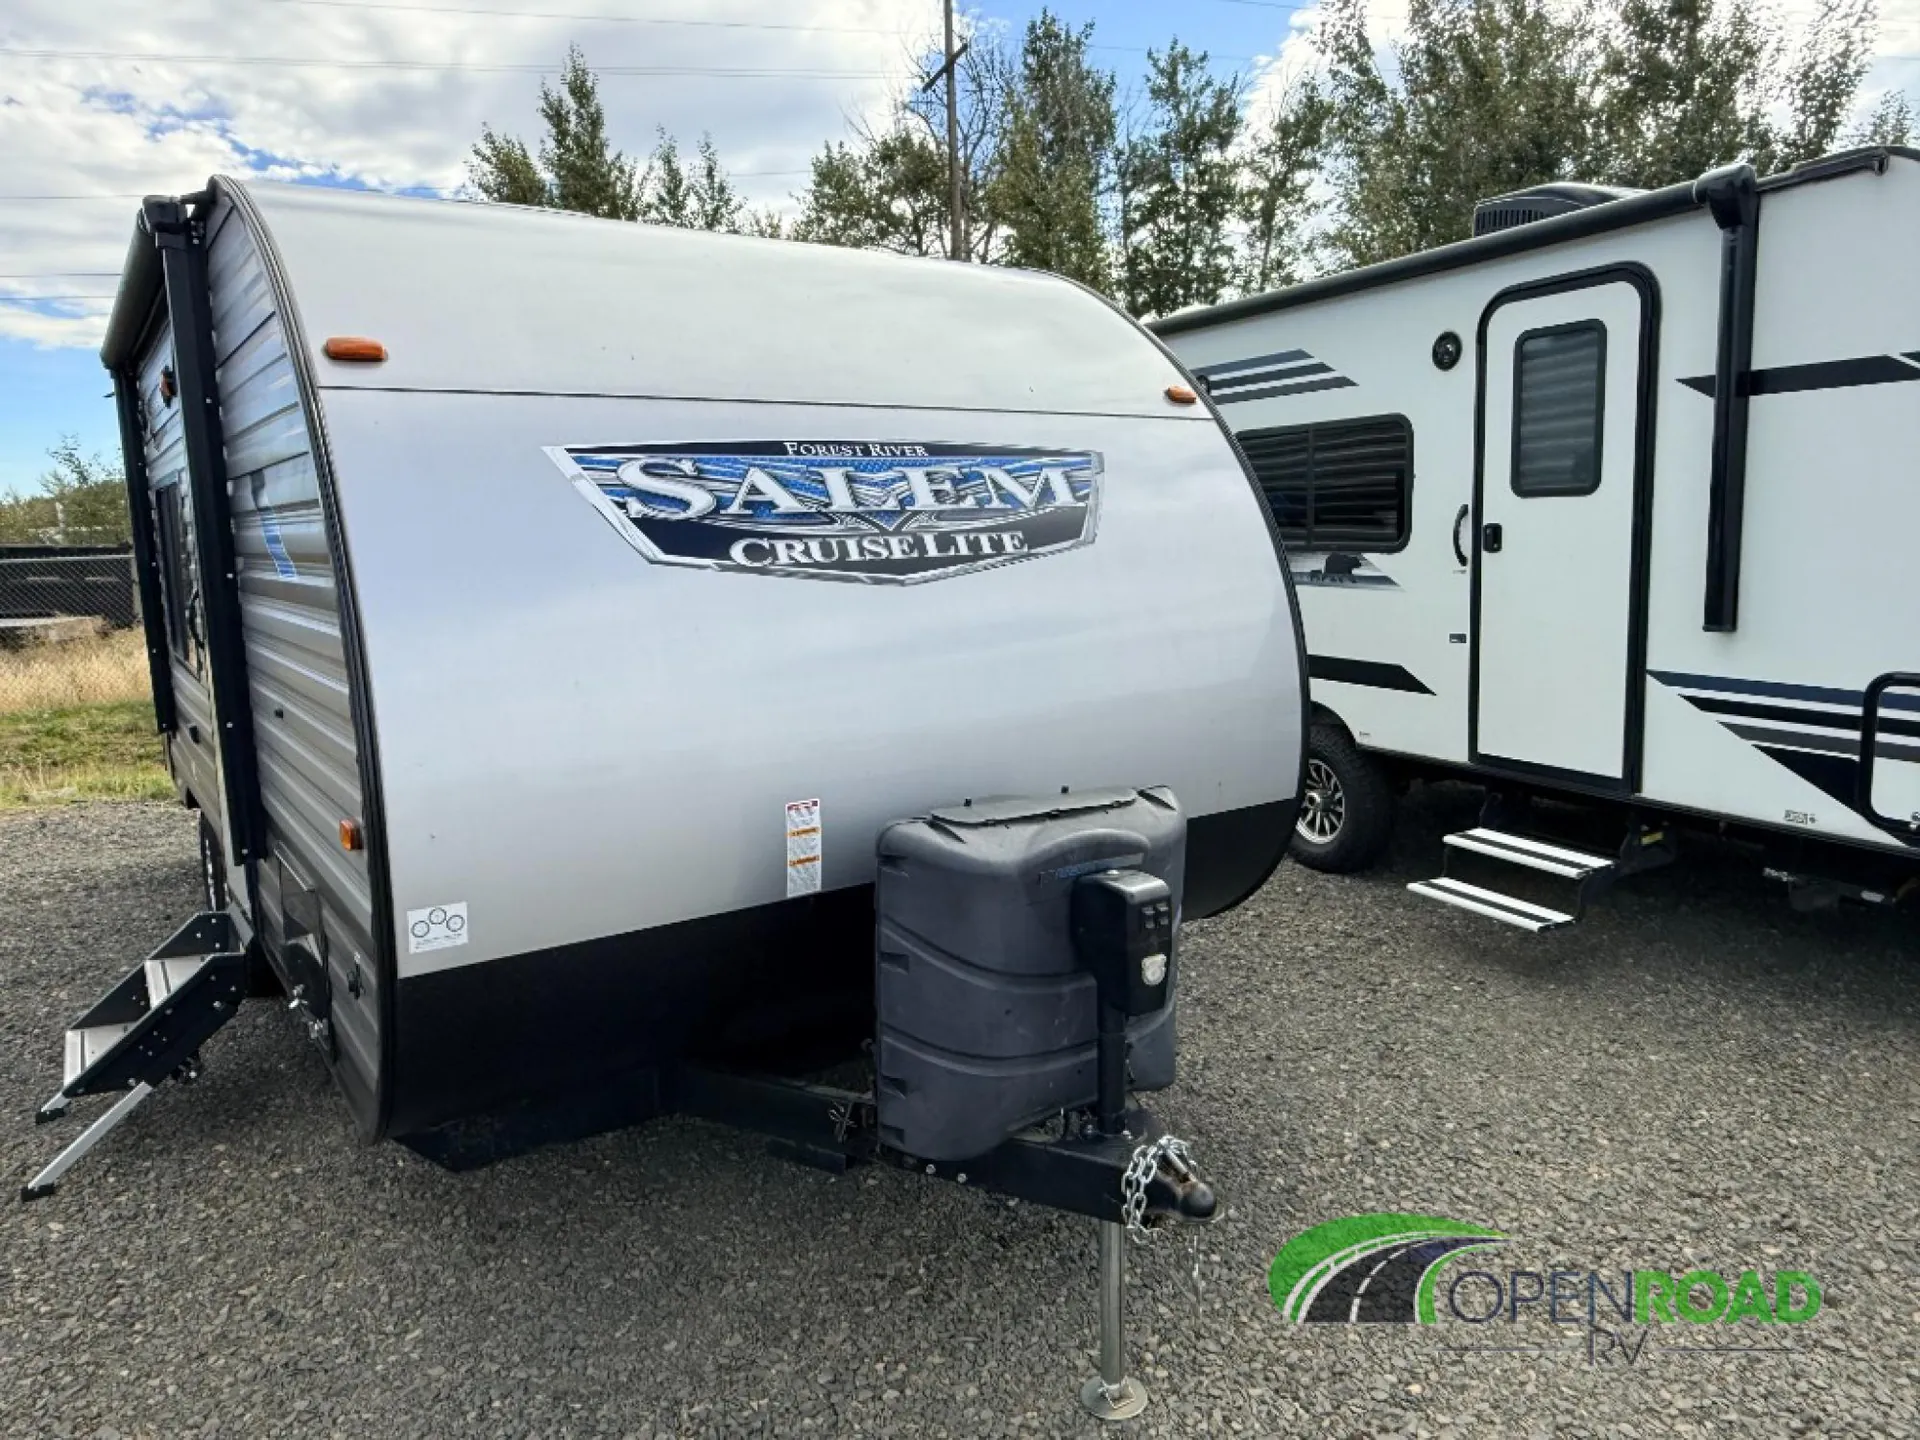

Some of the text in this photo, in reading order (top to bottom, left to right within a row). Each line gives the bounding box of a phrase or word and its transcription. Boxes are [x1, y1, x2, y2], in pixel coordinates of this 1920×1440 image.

[784, 441, 929, 457] FOREST RIVER
[616, 457, 1088, 519] SALEM
